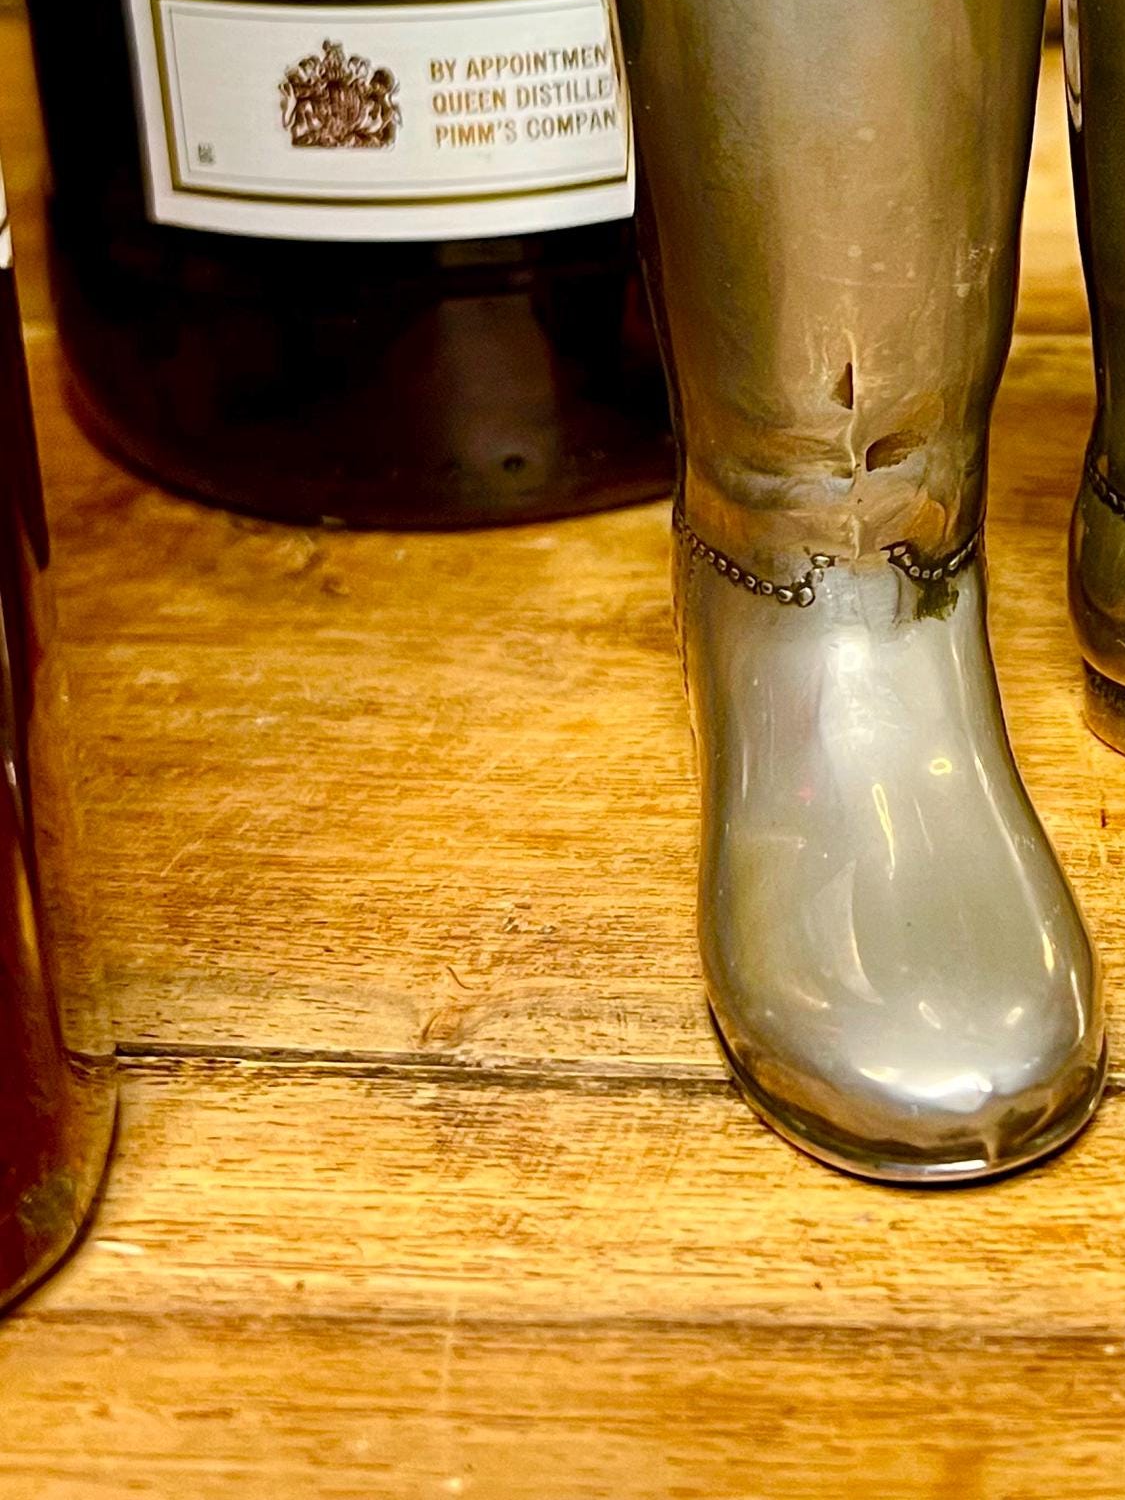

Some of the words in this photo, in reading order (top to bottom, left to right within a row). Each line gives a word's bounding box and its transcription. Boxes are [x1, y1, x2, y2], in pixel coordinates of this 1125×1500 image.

[429, 58, 457, 82] BY
[465, 44, 608, 81] APPOINTMEN
[432, 88, 508, 116] QUEEN
[516, 74, 613, 109] DISTILLE
[435, 118, 518, 149] PIMM'S
[526, 108, 616, 141] COMPAN
